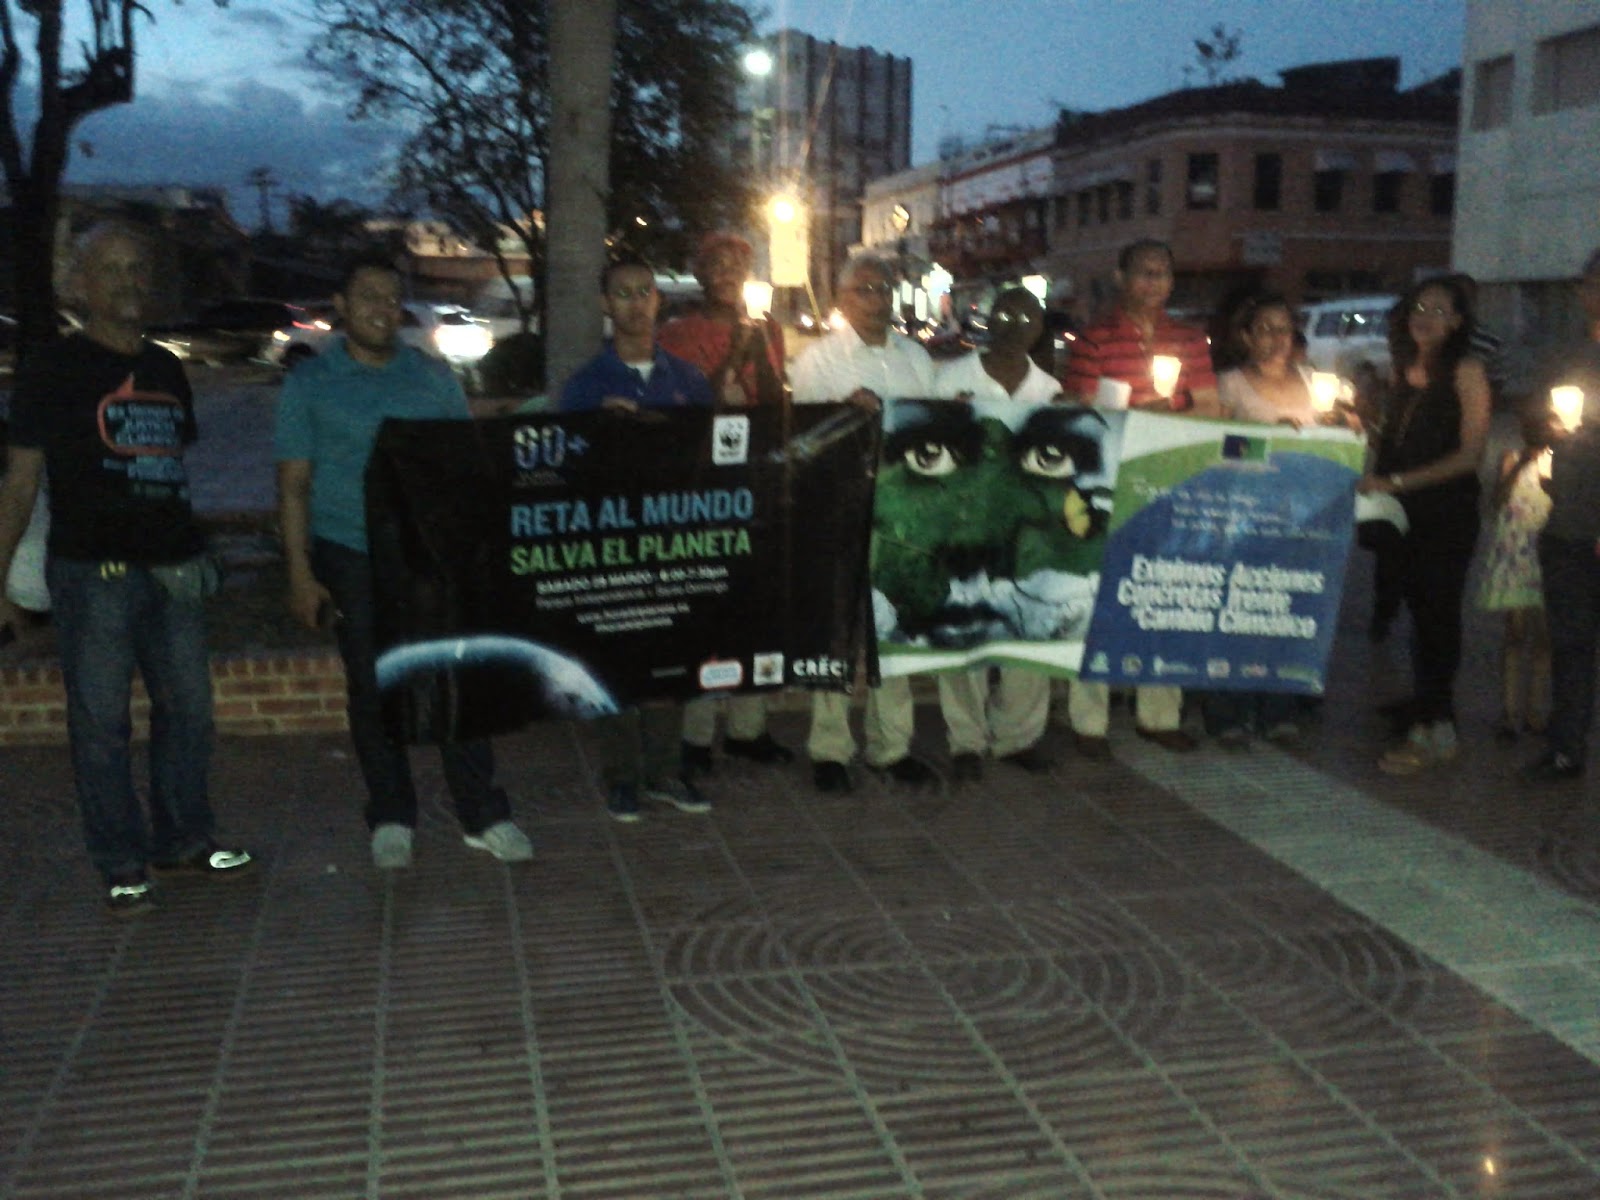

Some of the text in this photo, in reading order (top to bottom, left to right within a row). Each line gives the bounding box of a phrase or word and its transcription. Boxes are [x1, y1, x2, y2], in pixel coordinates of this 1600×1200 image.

[511, 487, 755, 537] RETA AL MUNDO
[511, 527, 752, 576] SALVA EL PLANETA
